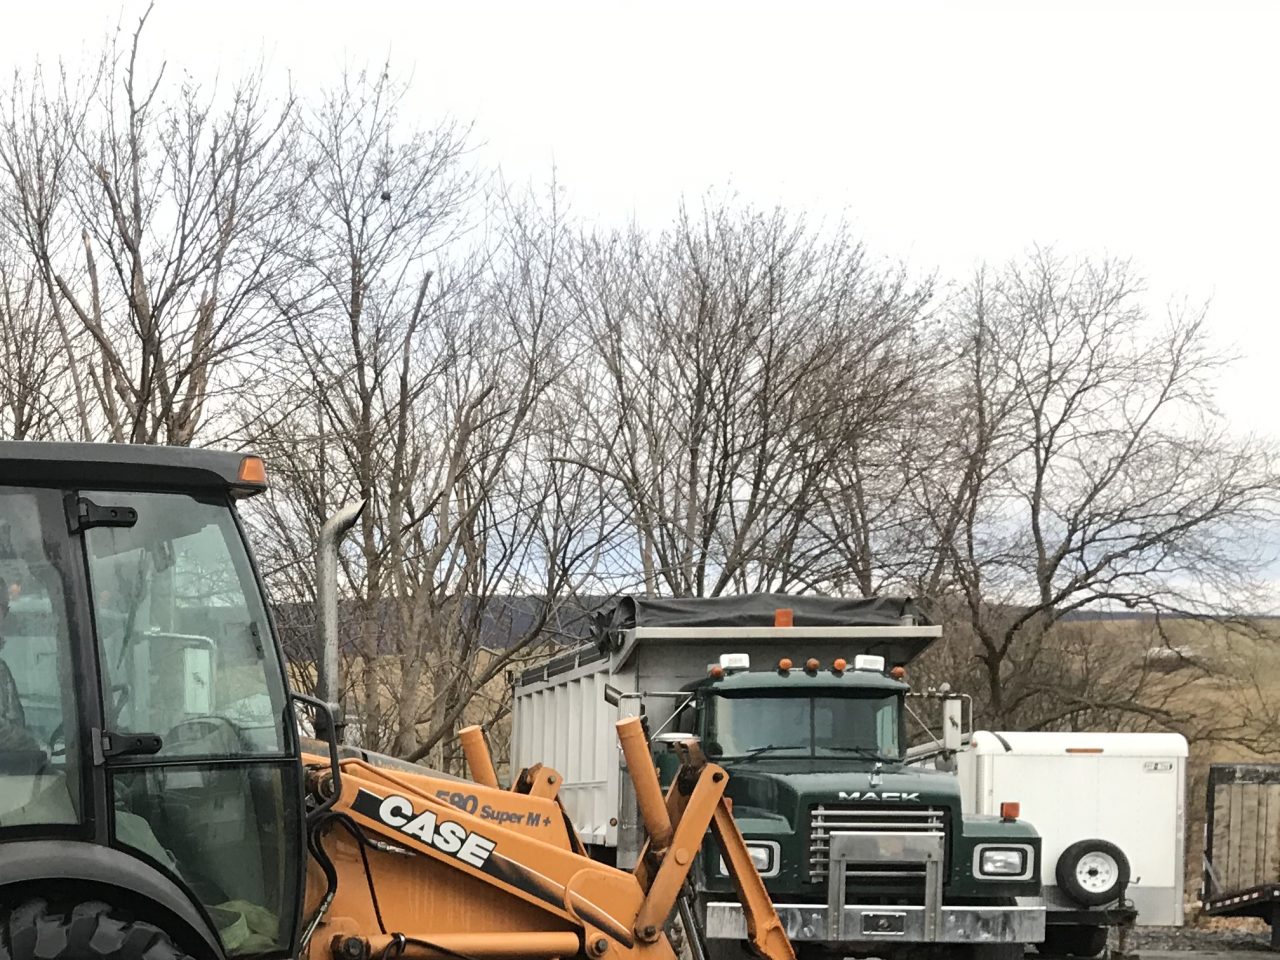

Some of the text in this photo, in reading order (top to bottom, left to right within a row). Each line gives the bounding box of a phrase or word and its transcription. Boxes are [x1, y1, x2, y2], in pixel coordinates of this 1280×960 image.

[838, 791, 920, 802] MACK
[480, 805, 525, 825] Super
[378, 794, 497, 869] CASE
